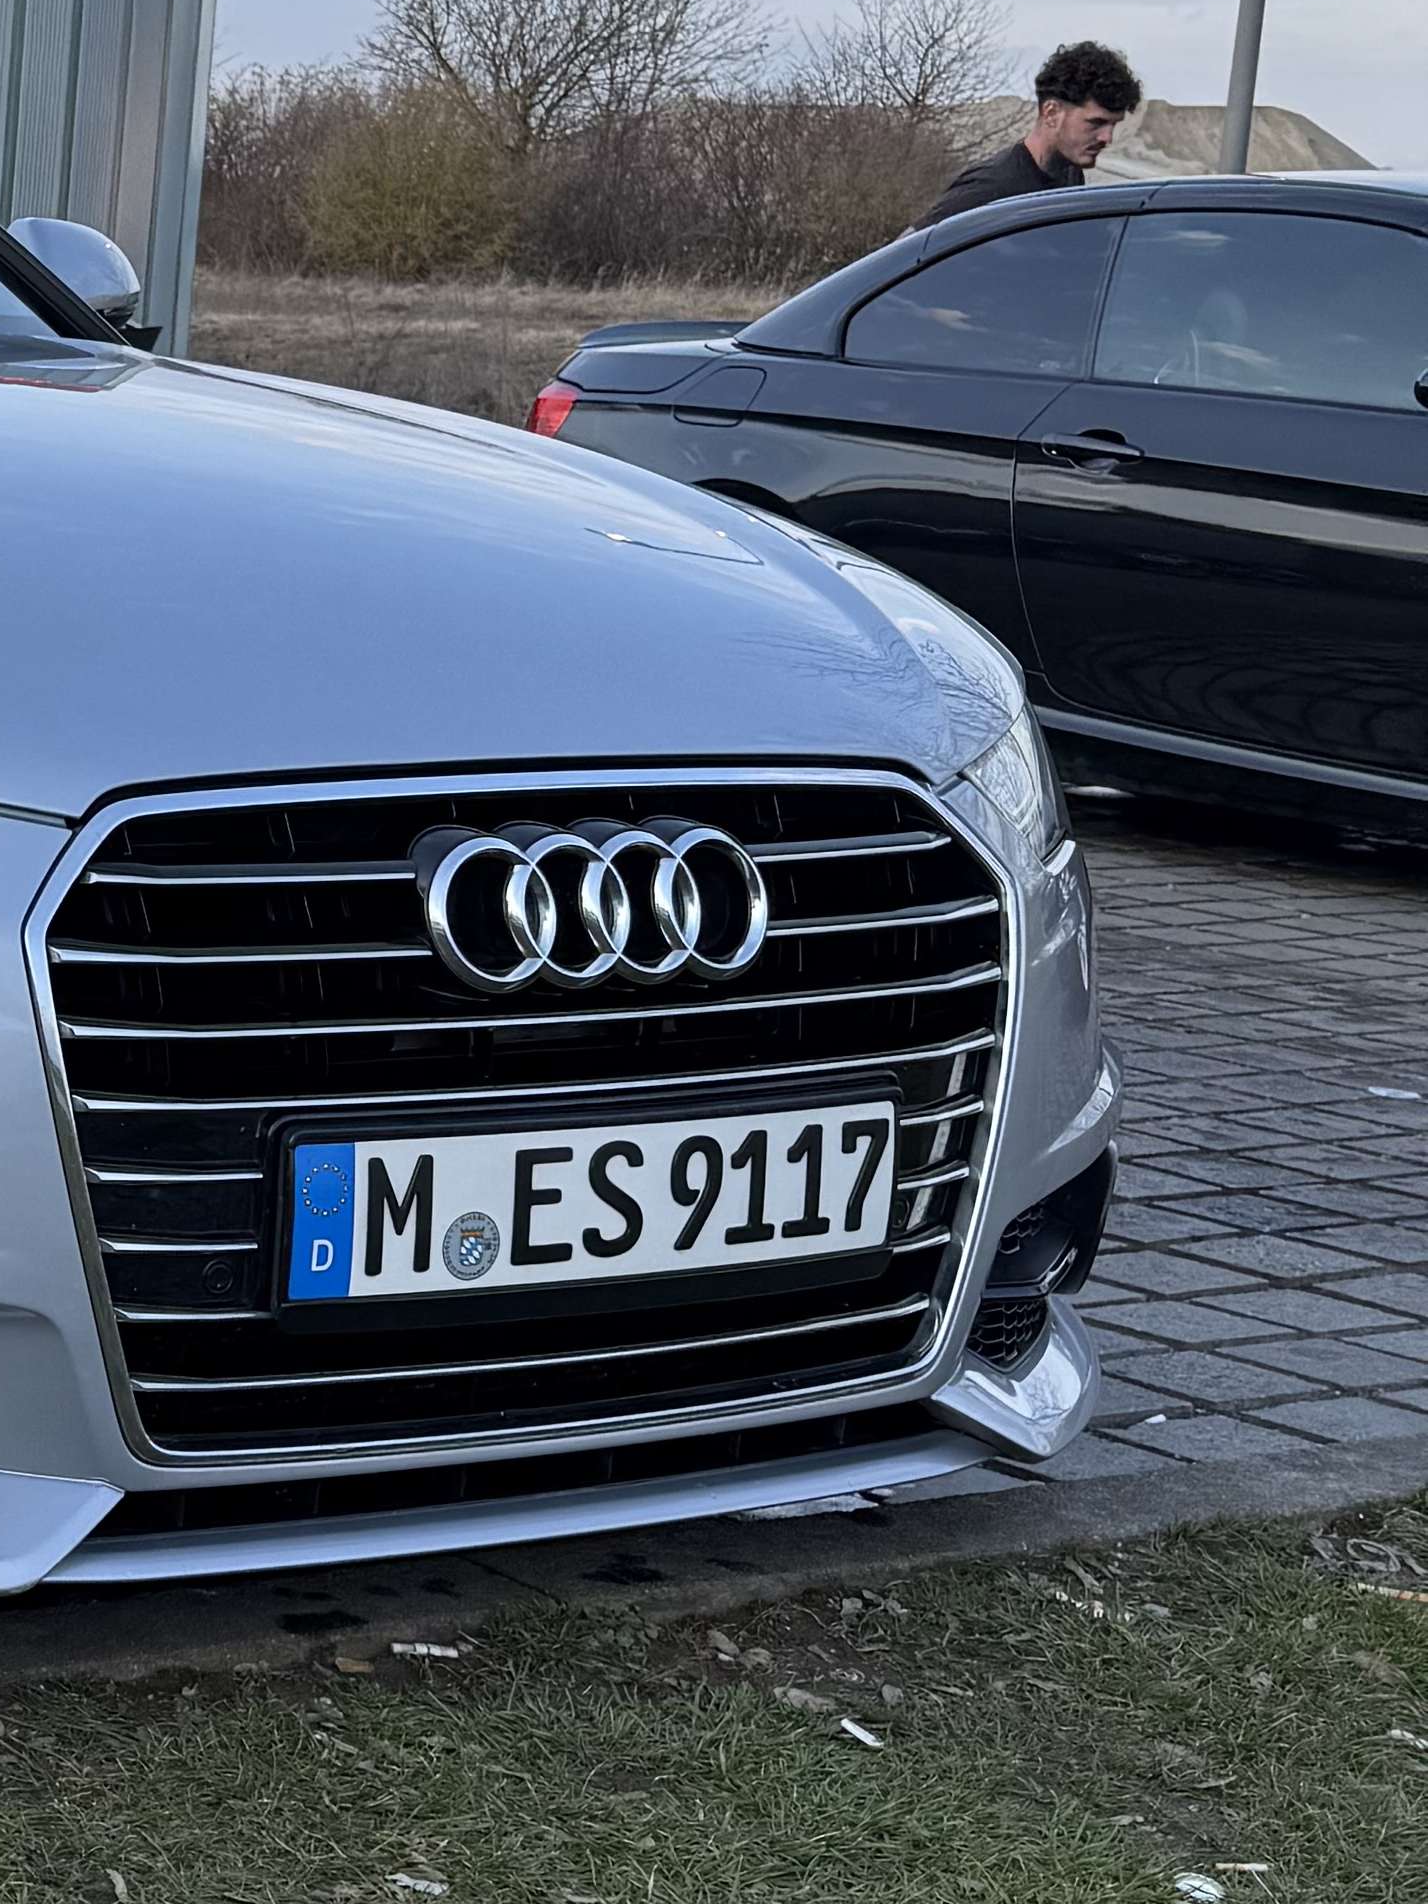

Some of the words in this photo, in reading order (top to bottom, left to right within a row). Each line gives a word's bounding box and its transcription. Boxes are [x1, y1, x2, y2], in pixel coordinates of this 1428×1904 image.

[364, 1154, 434, 1277] M
[510, 1140, 644, 1266] ES
[670, 1118, 890, 1251] 9117
[310, 1239, 334, 1272] D
